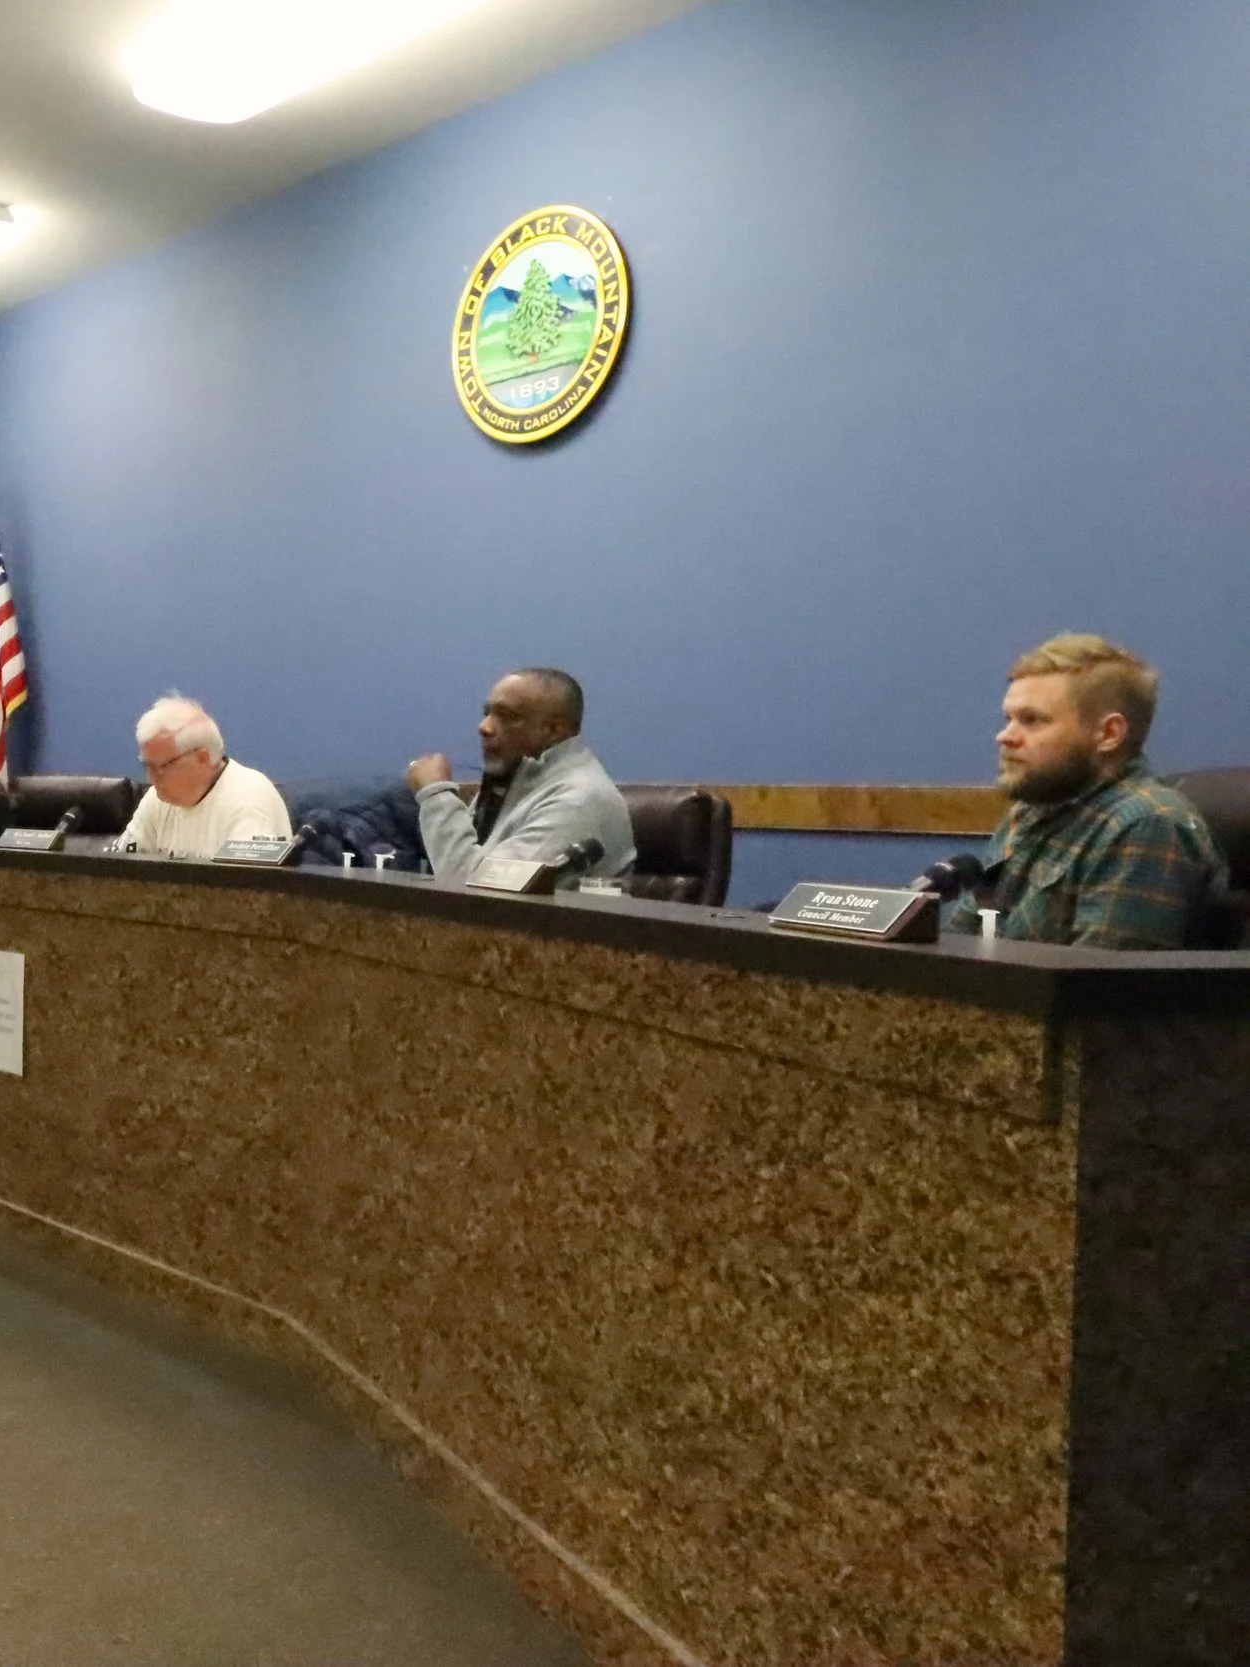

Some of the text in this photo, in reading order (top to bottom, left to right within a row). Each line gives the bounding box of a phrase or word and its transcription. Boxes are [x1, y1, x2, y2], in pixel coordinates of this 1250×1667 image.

[458, 215, 619, 413] TOWN OF BLACK MOUNTAIN
[510, 375, 560, 398] 1893
[482, 385, 587, 431] NORTH CAROLINA
[811, 891, 879, 908] Ryan Stone
[797, 909, 865, 925] Council Member
